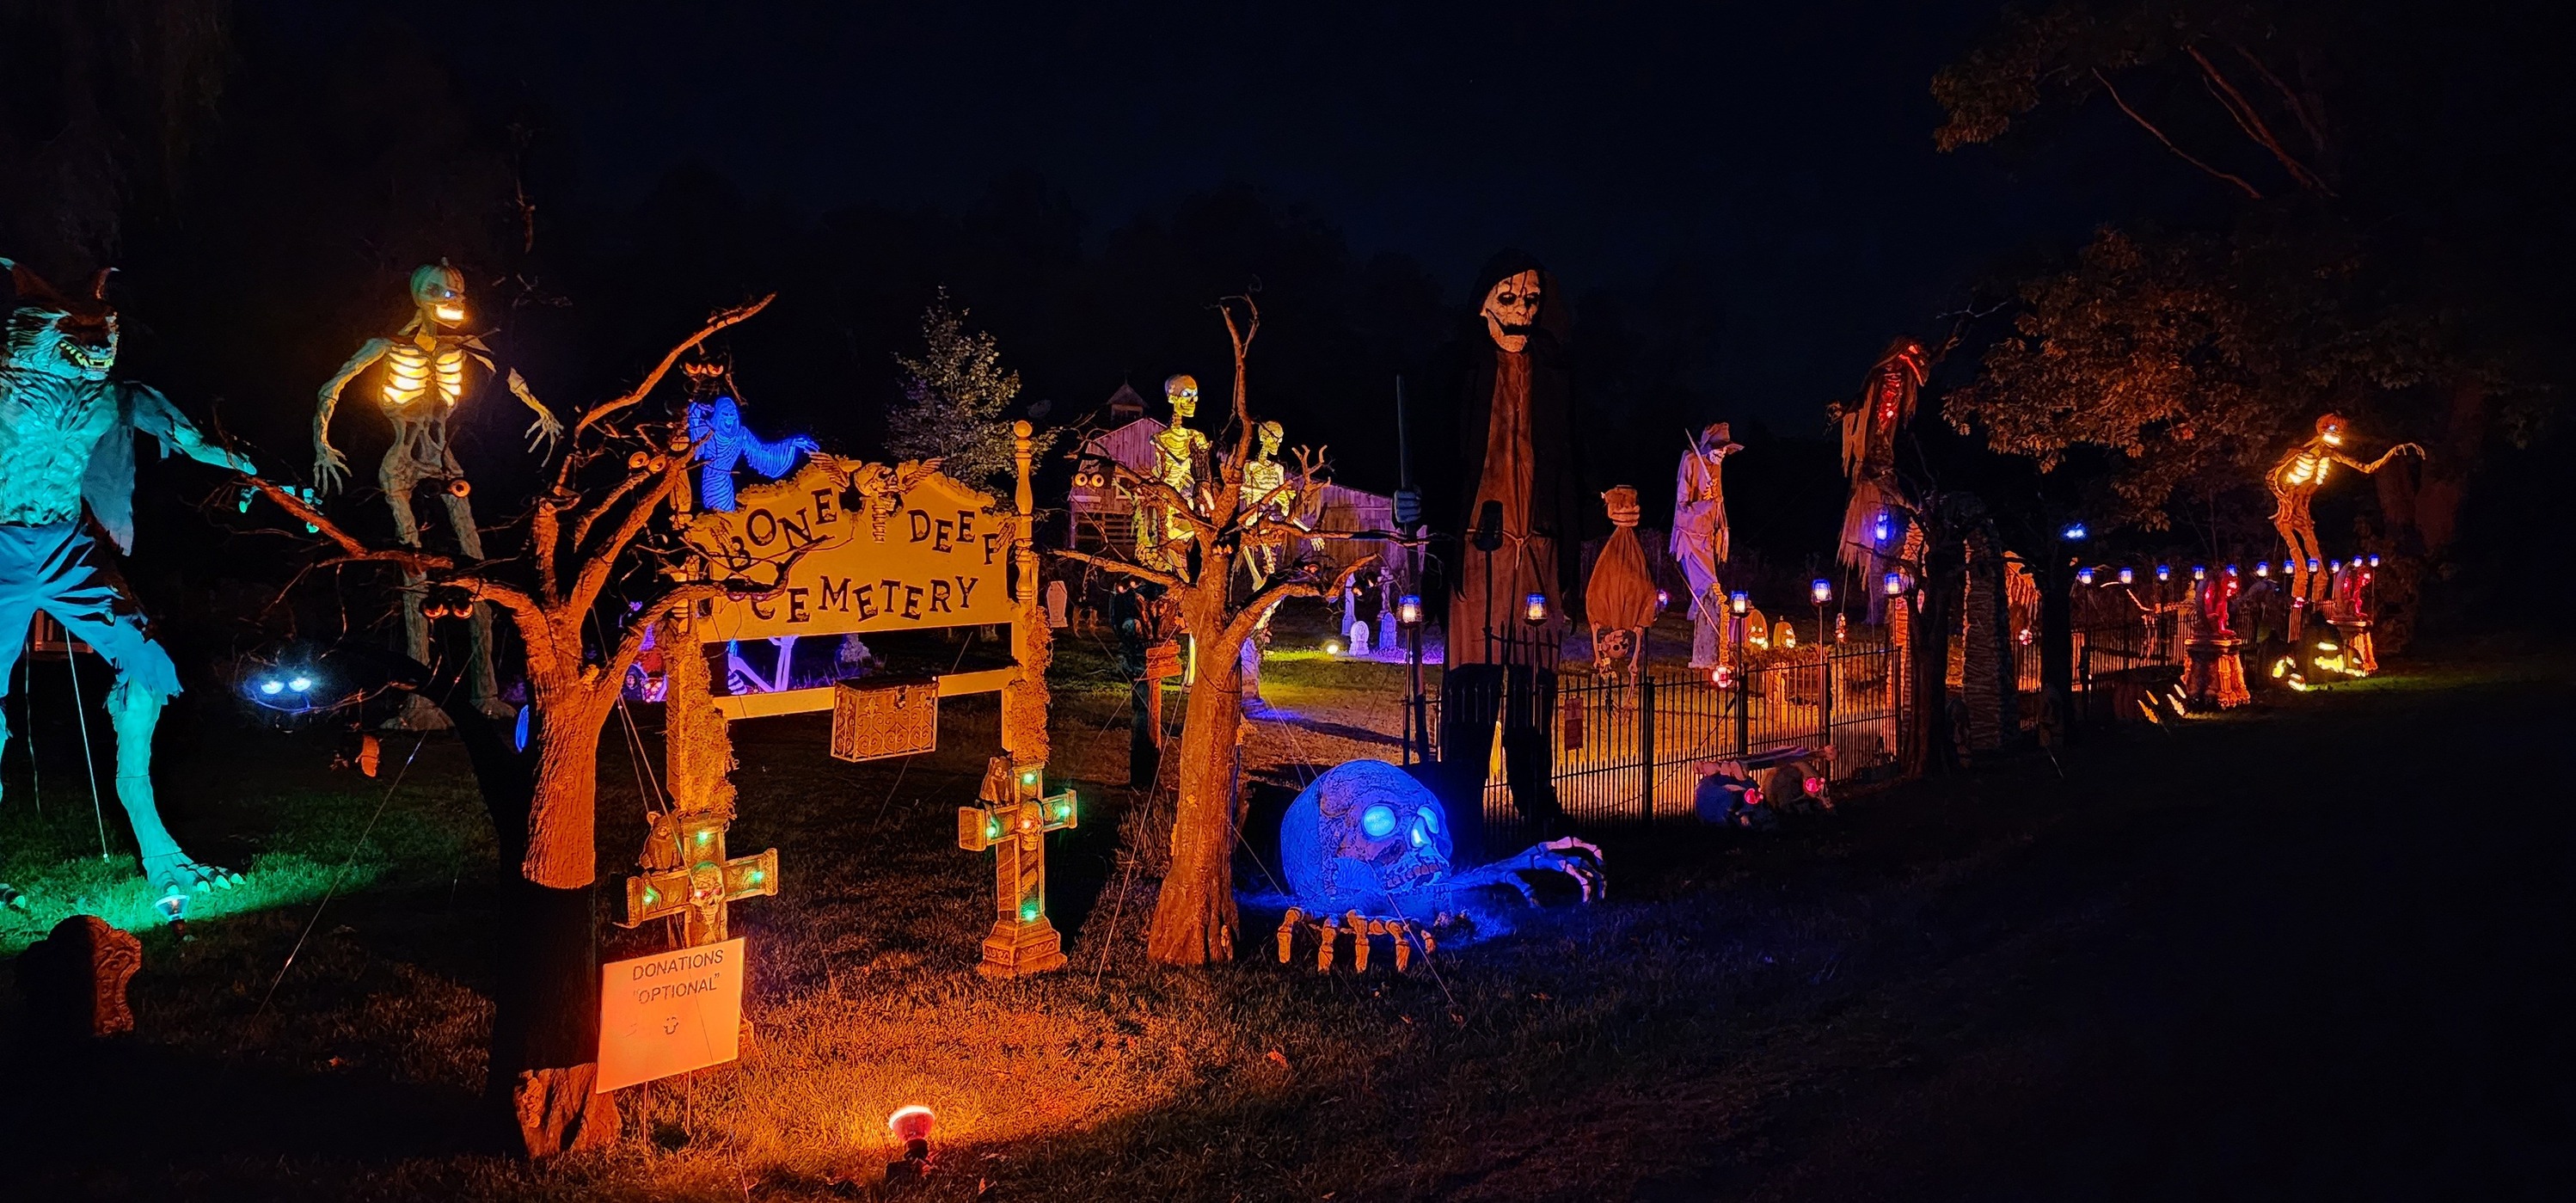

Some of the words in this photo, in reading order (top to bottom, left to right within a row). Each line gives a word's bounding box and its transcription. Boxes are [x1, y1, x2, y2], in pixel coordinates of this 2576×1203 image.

[721, 488, 837, 574] BONE
[751, 575, 979, 623] CEMETERY
[633, 949, 724, 981] DONATIONS
